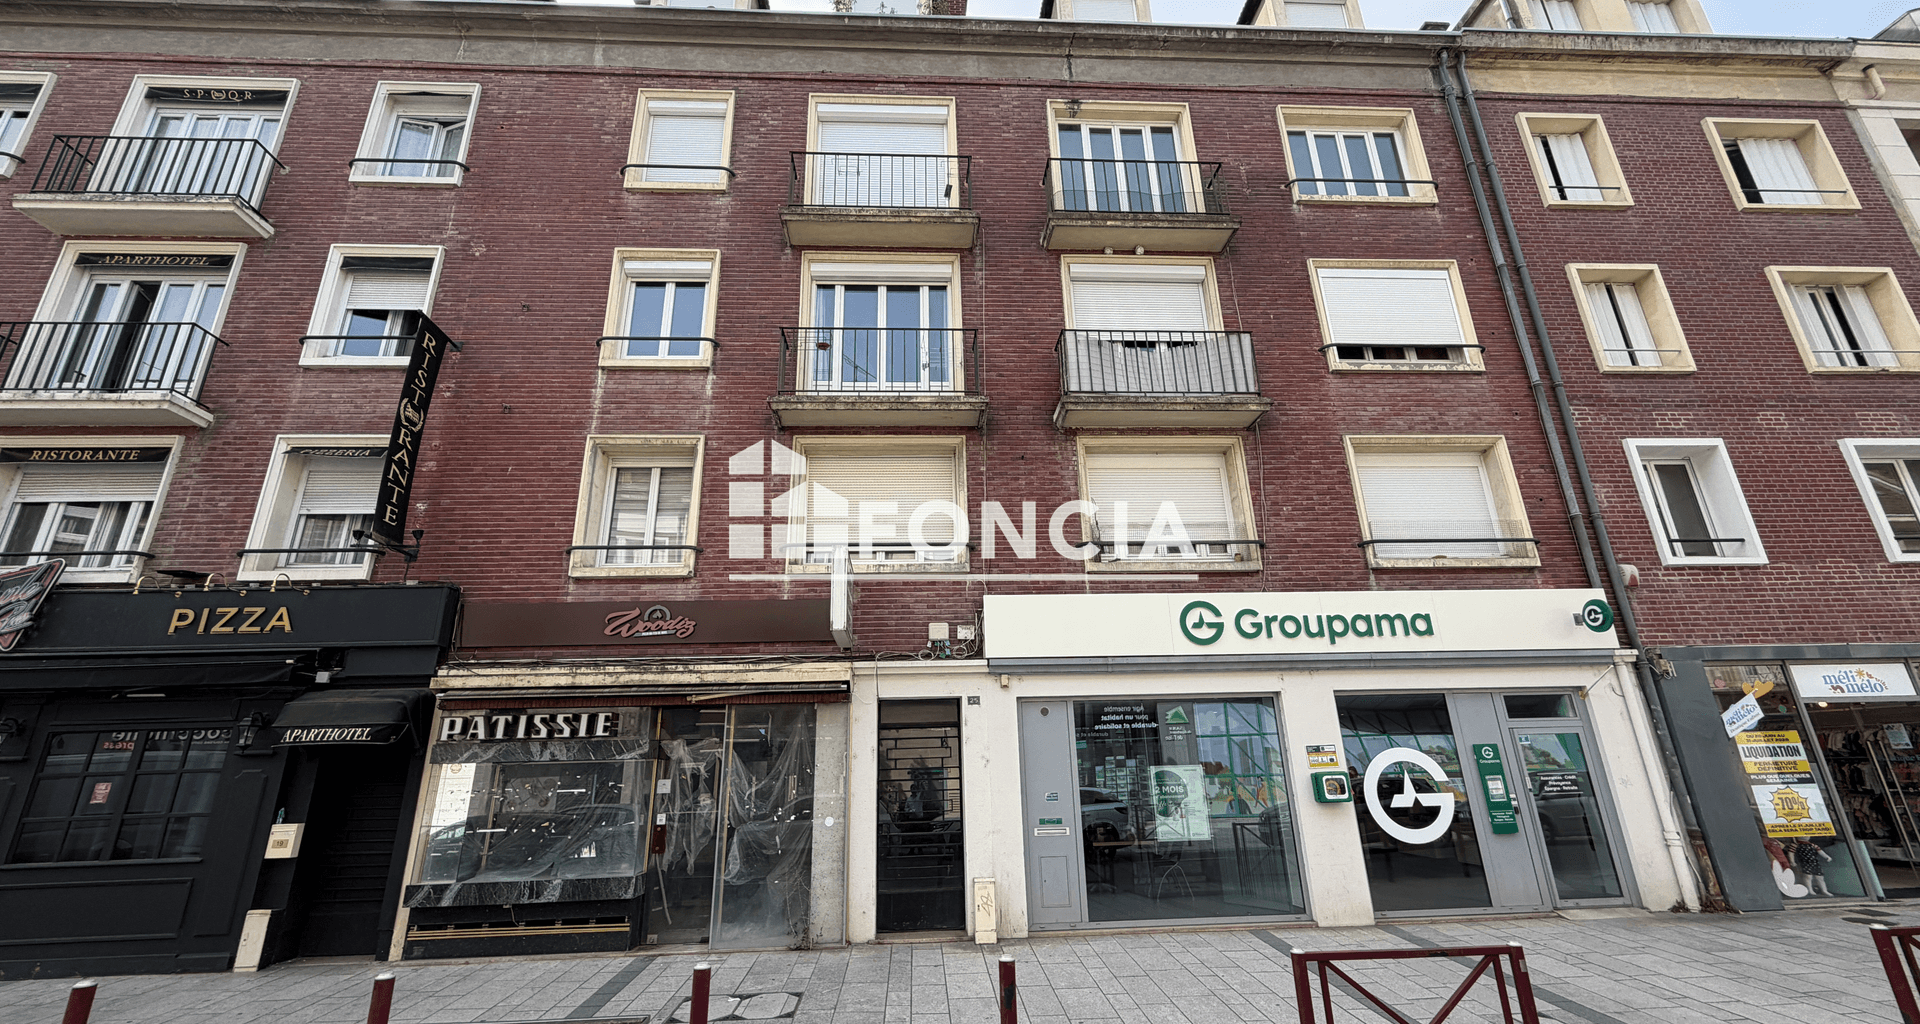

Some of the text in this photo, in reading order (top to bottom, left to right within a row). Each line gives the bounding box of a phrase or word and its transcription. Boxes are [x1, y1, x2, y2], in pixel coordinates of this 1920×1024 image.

[98, 255, 210, 265] APARTHOTEL
[29, 450, 140, 460] RISTORANTE
[167, 606, 294, 635] PIZZA
[604, 607, 696, 638] Woodiz
[1234, 608, 1435, 645] Groupama
[1822, 670, 1857, 685] méli
[1845, 679, 1884, 693] mélo
[439, 712, 613, 742] PATISSIE
[280, 728, 372, 742] APARTHOTEL
[1742, 745, 1801, 759] LIQUIDATION
[1162, 785, 1184, 793] MOIS
